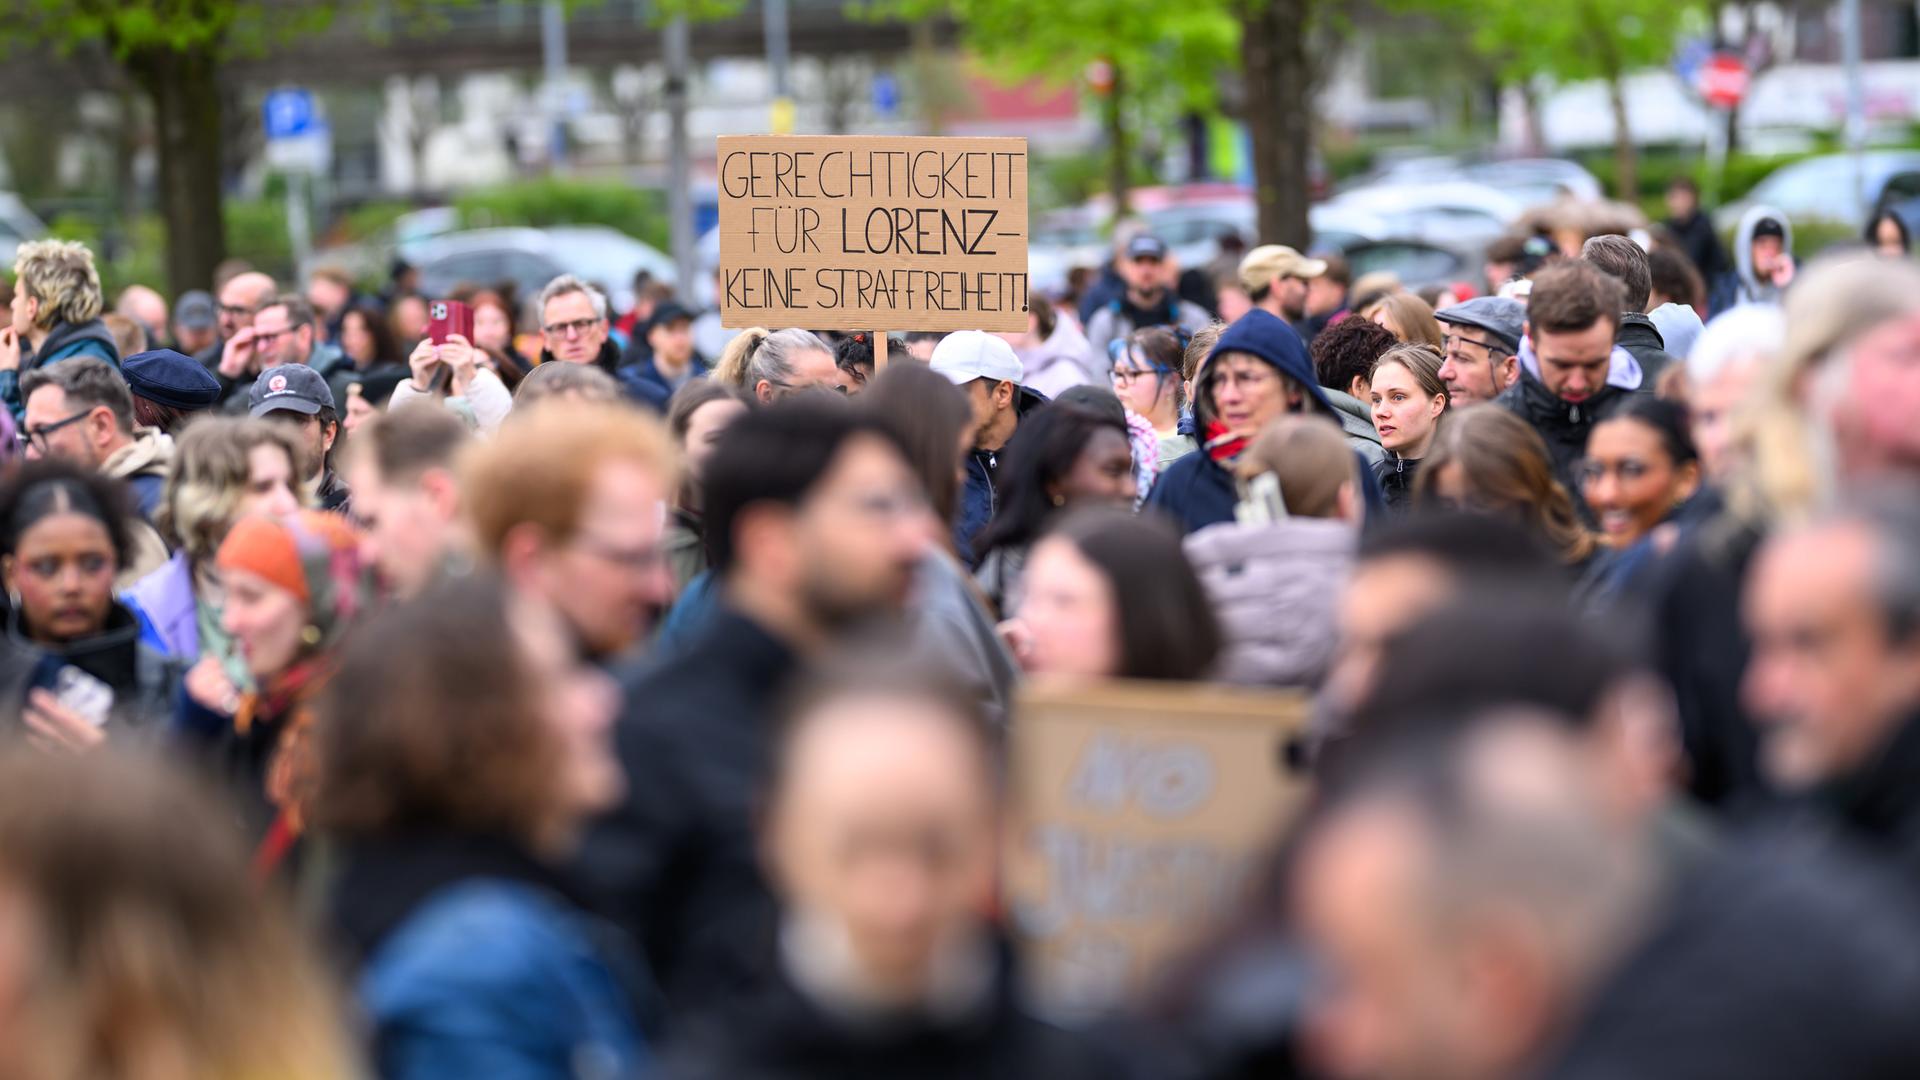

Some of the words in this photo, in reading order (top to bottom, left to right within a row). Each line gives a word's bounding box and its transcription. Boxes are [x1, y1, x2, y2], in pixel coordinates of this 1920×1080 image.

[722, 150, 1025, 199] GERECHTIGKEIT
[747, 204, 821, 254] FÜR
[725, 268, 808, 309] KEINE
[815, 268, 1029, 312] STRAFFREIHEIT!
